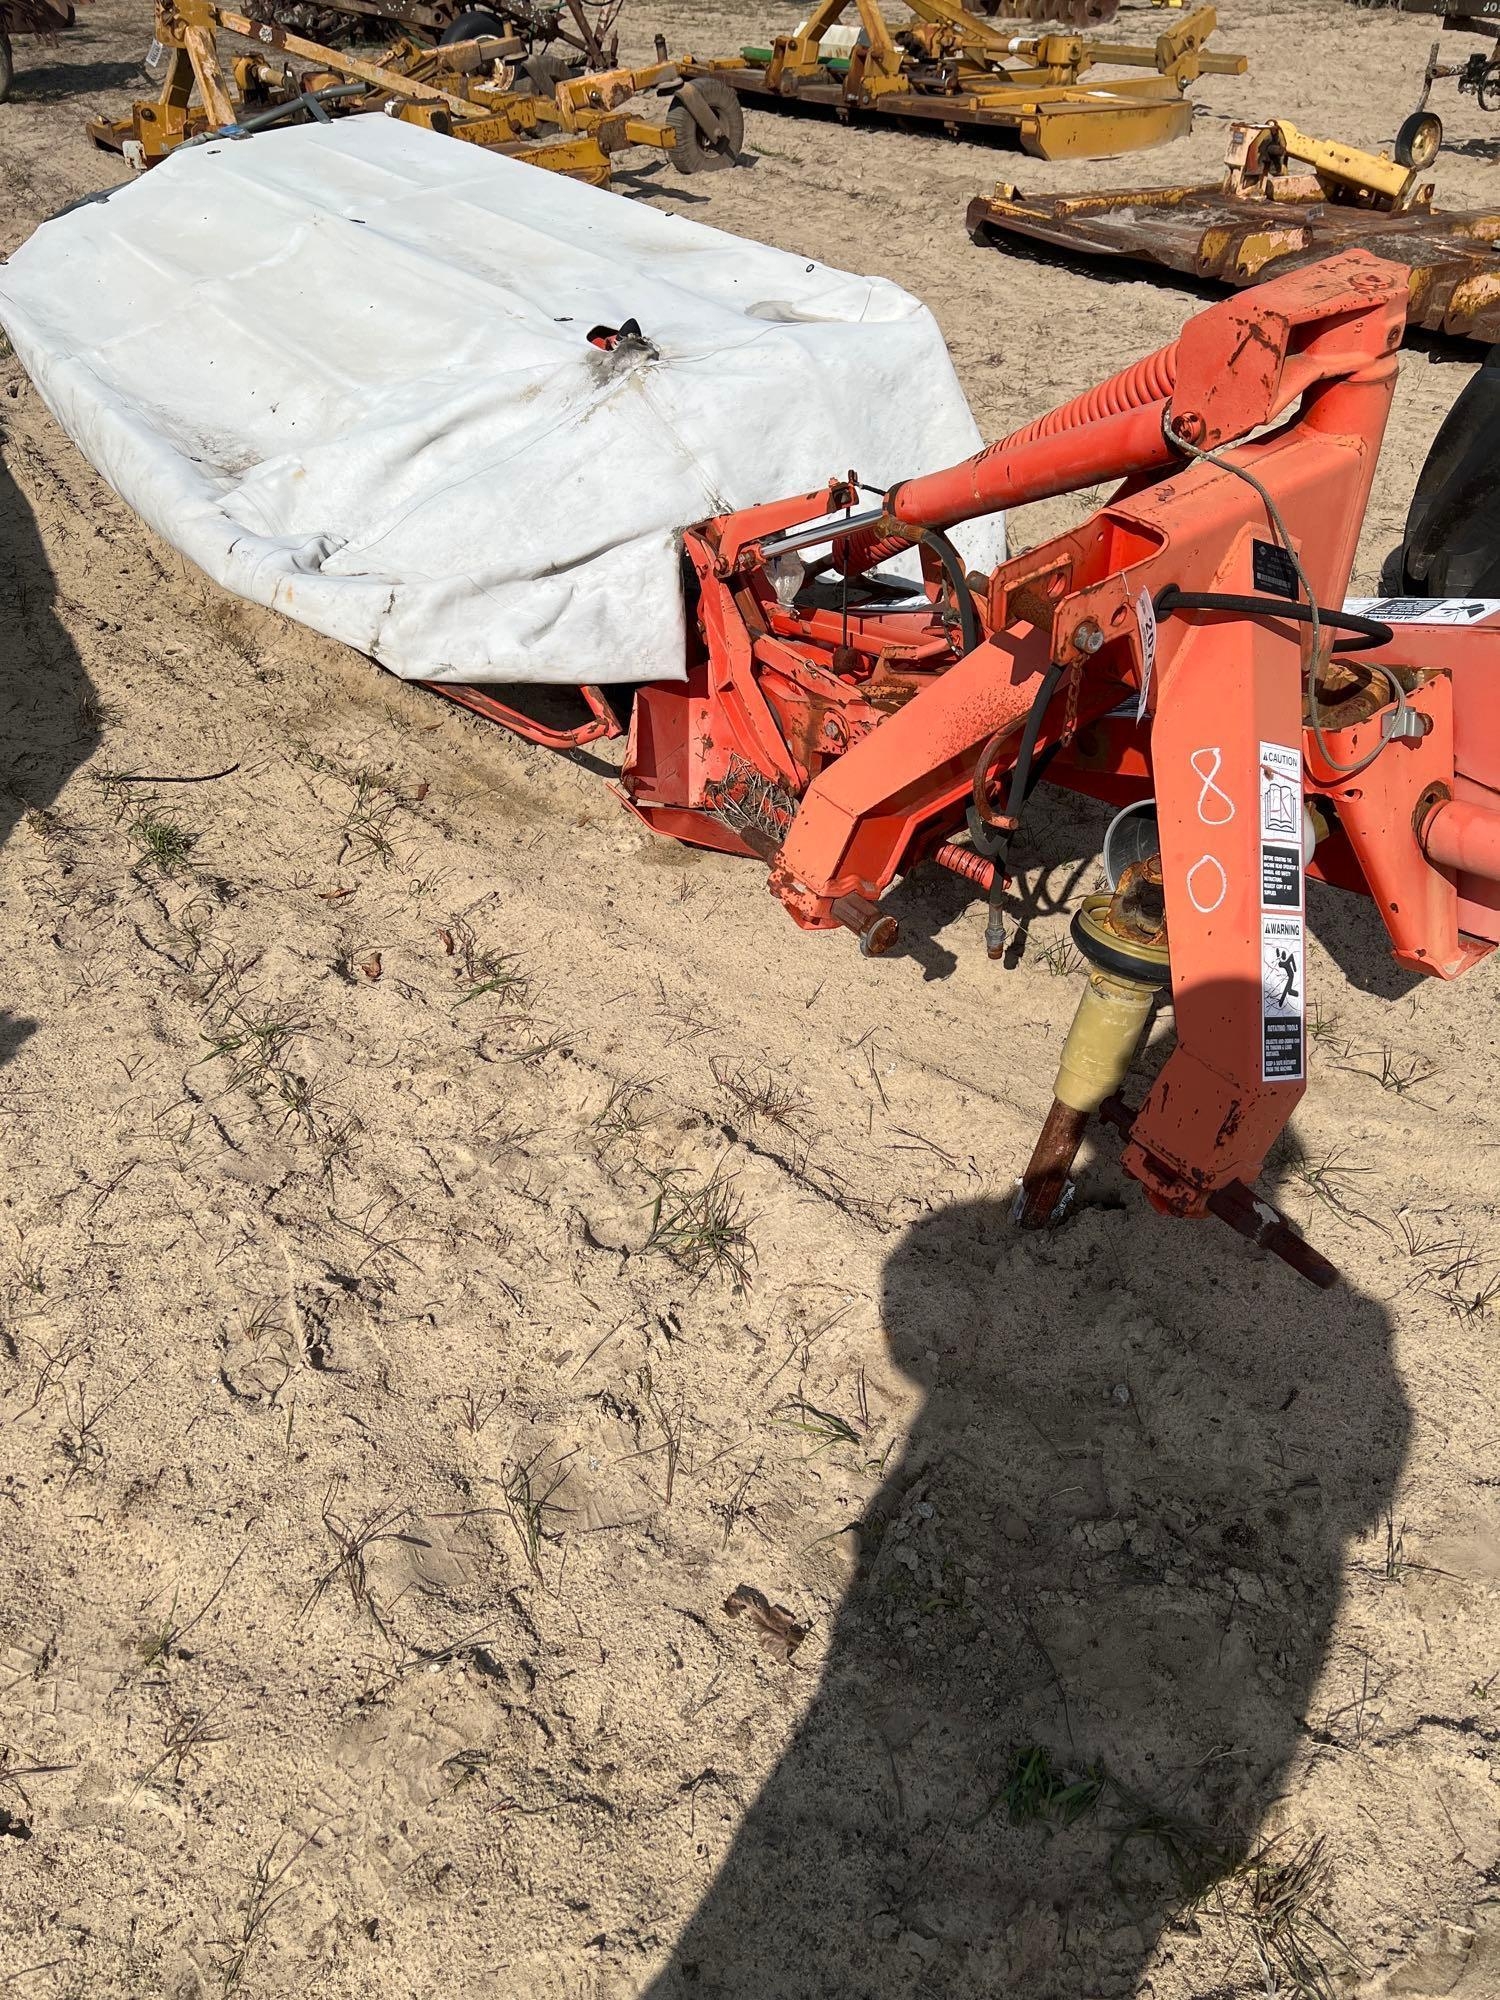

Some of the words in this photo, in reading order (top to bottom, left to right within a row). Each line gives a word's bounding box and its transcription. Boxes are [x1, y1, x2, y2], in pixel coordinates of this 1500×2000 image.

[1483, 2, 1500, 12] JO
[1268, 752, 1298, 767] CAUTION
[1270, 923, 1299, 935] WARNING
